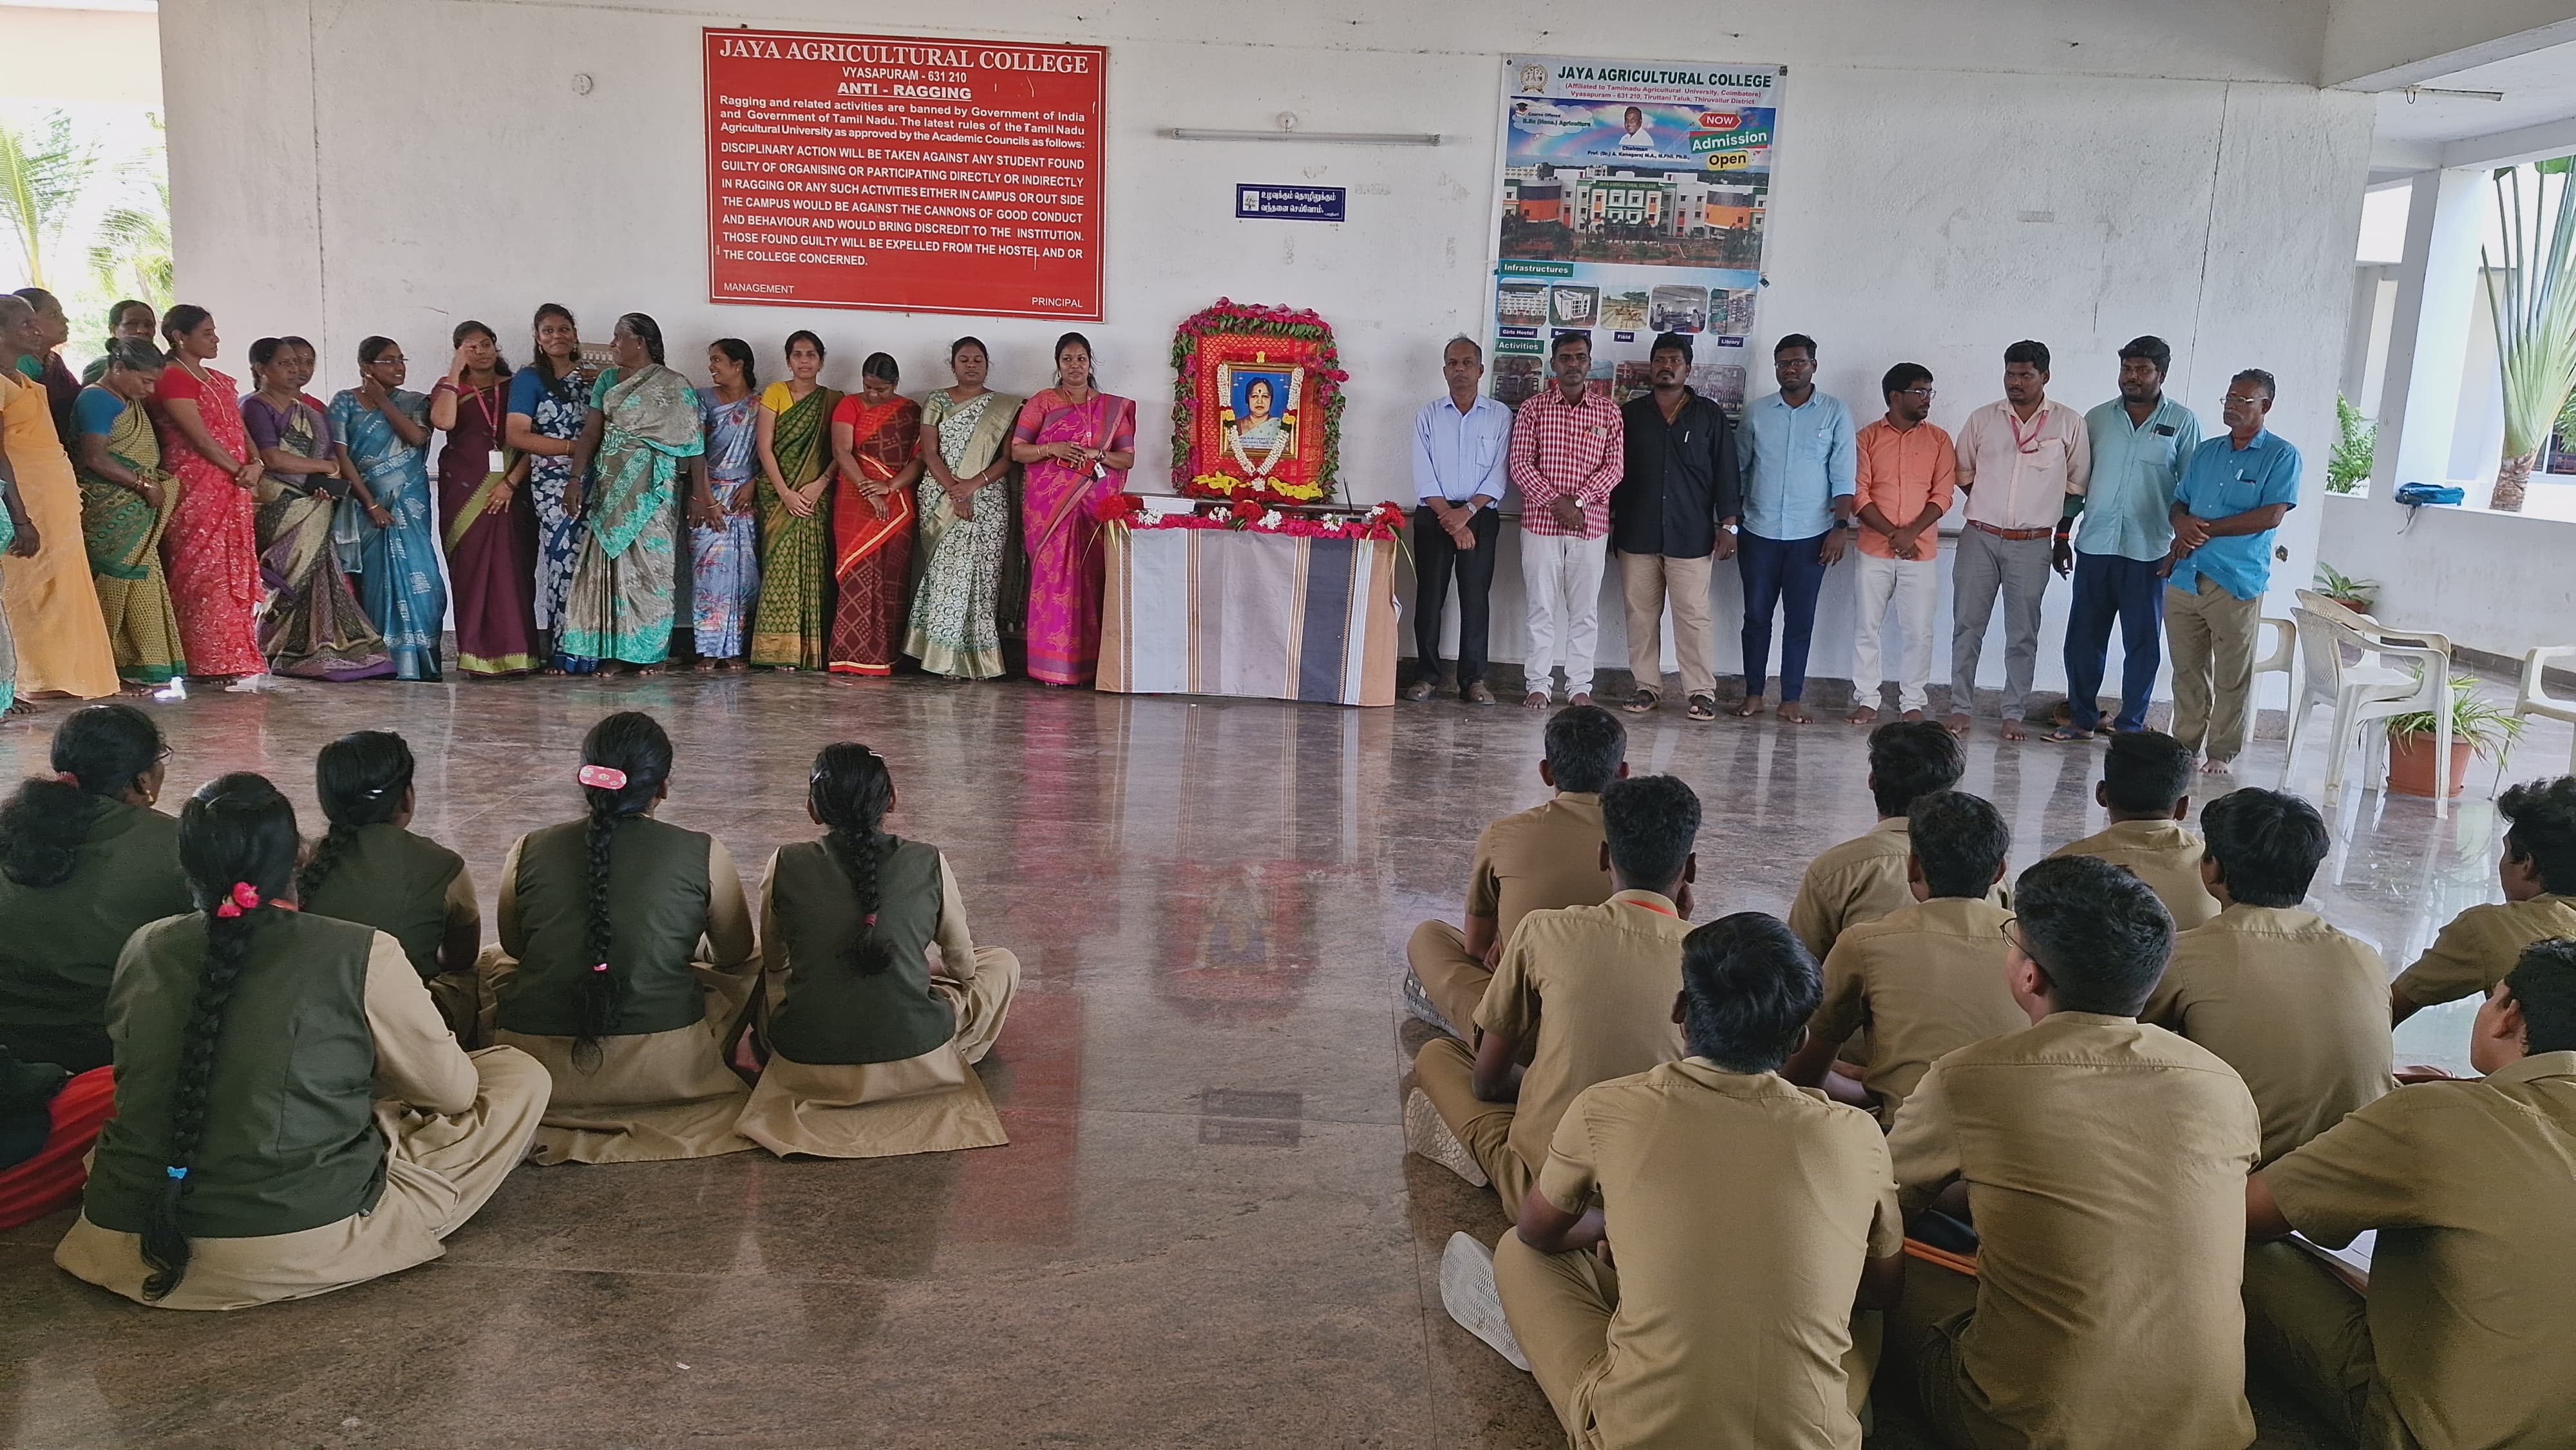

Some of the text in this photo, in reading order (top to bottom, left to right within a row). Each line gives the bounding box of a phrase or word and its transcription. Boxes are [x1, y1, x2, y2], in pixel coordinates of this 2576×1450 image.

[720, 39, 1087, 73] JAYA AGRICULTURAL COLLEGE
[843, 67, 918, 80] VYASAPURAM
[928, 71, 944, 81] 631
[949, 72, 966, 82] 210
[1558, 66, 1772, 88] JAYA AGRICULTURAL COLLEGE
[838, 82, 877, 94] ANTI
[894, 85, 971, 99] RAGGING
[1721, 89, 1761, 98] Coimbatore)
[720, 95, 766, 108] Ragging
[770, 99, 790, 107] and
[793, 99, 830, 108] related
[835, 102, 883, 111] activities
[910, 104, 951, 114] banned
[954, 106, 967, 117] by
[972, 107, 1038, 118] Government
[1043, 111, 1054, 120] of
[1058, 112, 1084, 121] India
[721, 109, 1084, 135] and Government of Tamil Nadu. The latest rules of the Tamil Nadu
[1707, 117, 1734, 125] NOW
[721, 122, 780, 133] Agricultural
[782, 125, 832, 137] University
[849, 130, 896, 138] approved
[900, 130, 912, 141] by
[913, 131, 929, 140] the
[932, 132, 982, 142] Academic
[985, 135, 1029, 145] Councils
[1045, 138, 1084, 147] follows:
[1692, 132, 1767, 151] Admission
[721, 142, 1084, 169] DISCIPLINARY ACTION WILL BE TAKEN AGAINST ANY STUDENT FOUND
[1709, 155, 1746, 168] Open
[722, 160, 1083, 187] GUILTY OF ORGANISING OR PARTICIPATING DIRECTLY OR INDIRECTLY
[722, 178, 1083, 205] IN RAGGING OR ANY SUCH ACTIVITIES EITHER IN CAMPUS OR OUT SIDE
[722, 196, 1082, 222] THE CAMPUS WOULD BE AGAINST THE CANNONS OF GOOD CONDUCT
[723, 214, 1083, 240] AND BEHAVIOUR AND WOULD BRING DISCREDIT TO THE INSTITUTION.
[723, 232, 1082, 258] THOSE FOUND GUILTY WILL BE EXPELLED FROM THE HOSTEL AND OR
[723, 250, 867, 265] THE COLLEGE CONCERNED.
[1504, 264, 1569, 274] Infrastructures
[724, 283, 793, 293] MANAGEMENT
[1032, 297, 1082, 307] PRINCIPAL
[1499, 342, 1539, 350] Activities
